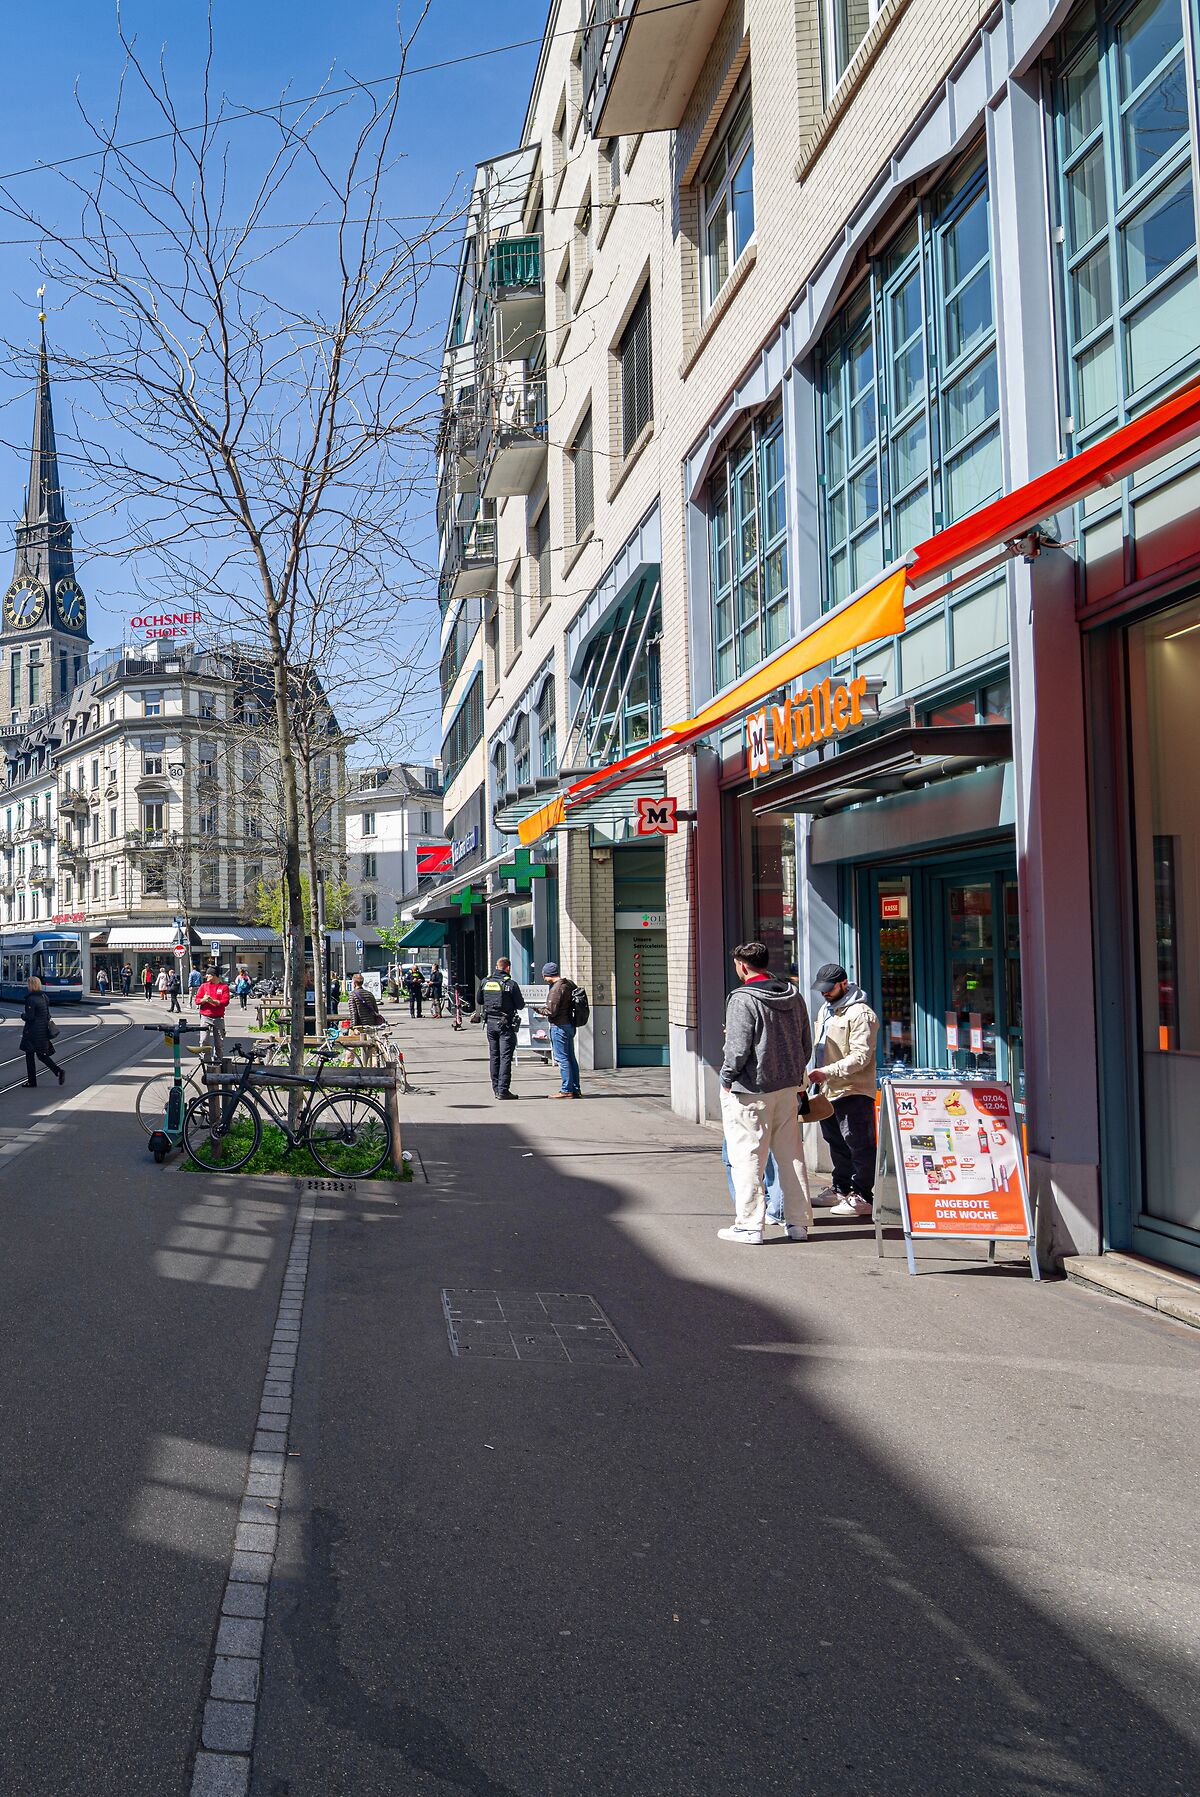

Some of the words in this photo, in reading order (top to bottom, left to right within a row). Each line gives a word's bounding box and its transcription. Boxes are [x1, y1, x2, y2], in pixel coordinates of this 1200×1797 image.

[130, 612, 202, 628] OCHSNER
[145, 626, 188, 639] SHOES
[770, 674, 867, 761] Müller
[171, 768, 183, 777] 30
[646, 807, 668, 825] M
[884, 904, 898, 912] KASSE
[982, 1094, 1006, 1102] 07.04.
[901, 1102, 913, 1111] M
[984, 1102, 1008, 1110] 12.04.
[934, 1199, 990, 1209] ANGEBOTE
[936, 1210, 957, 1219] DER
[959, 1211, 998, 1220] WOCHE
